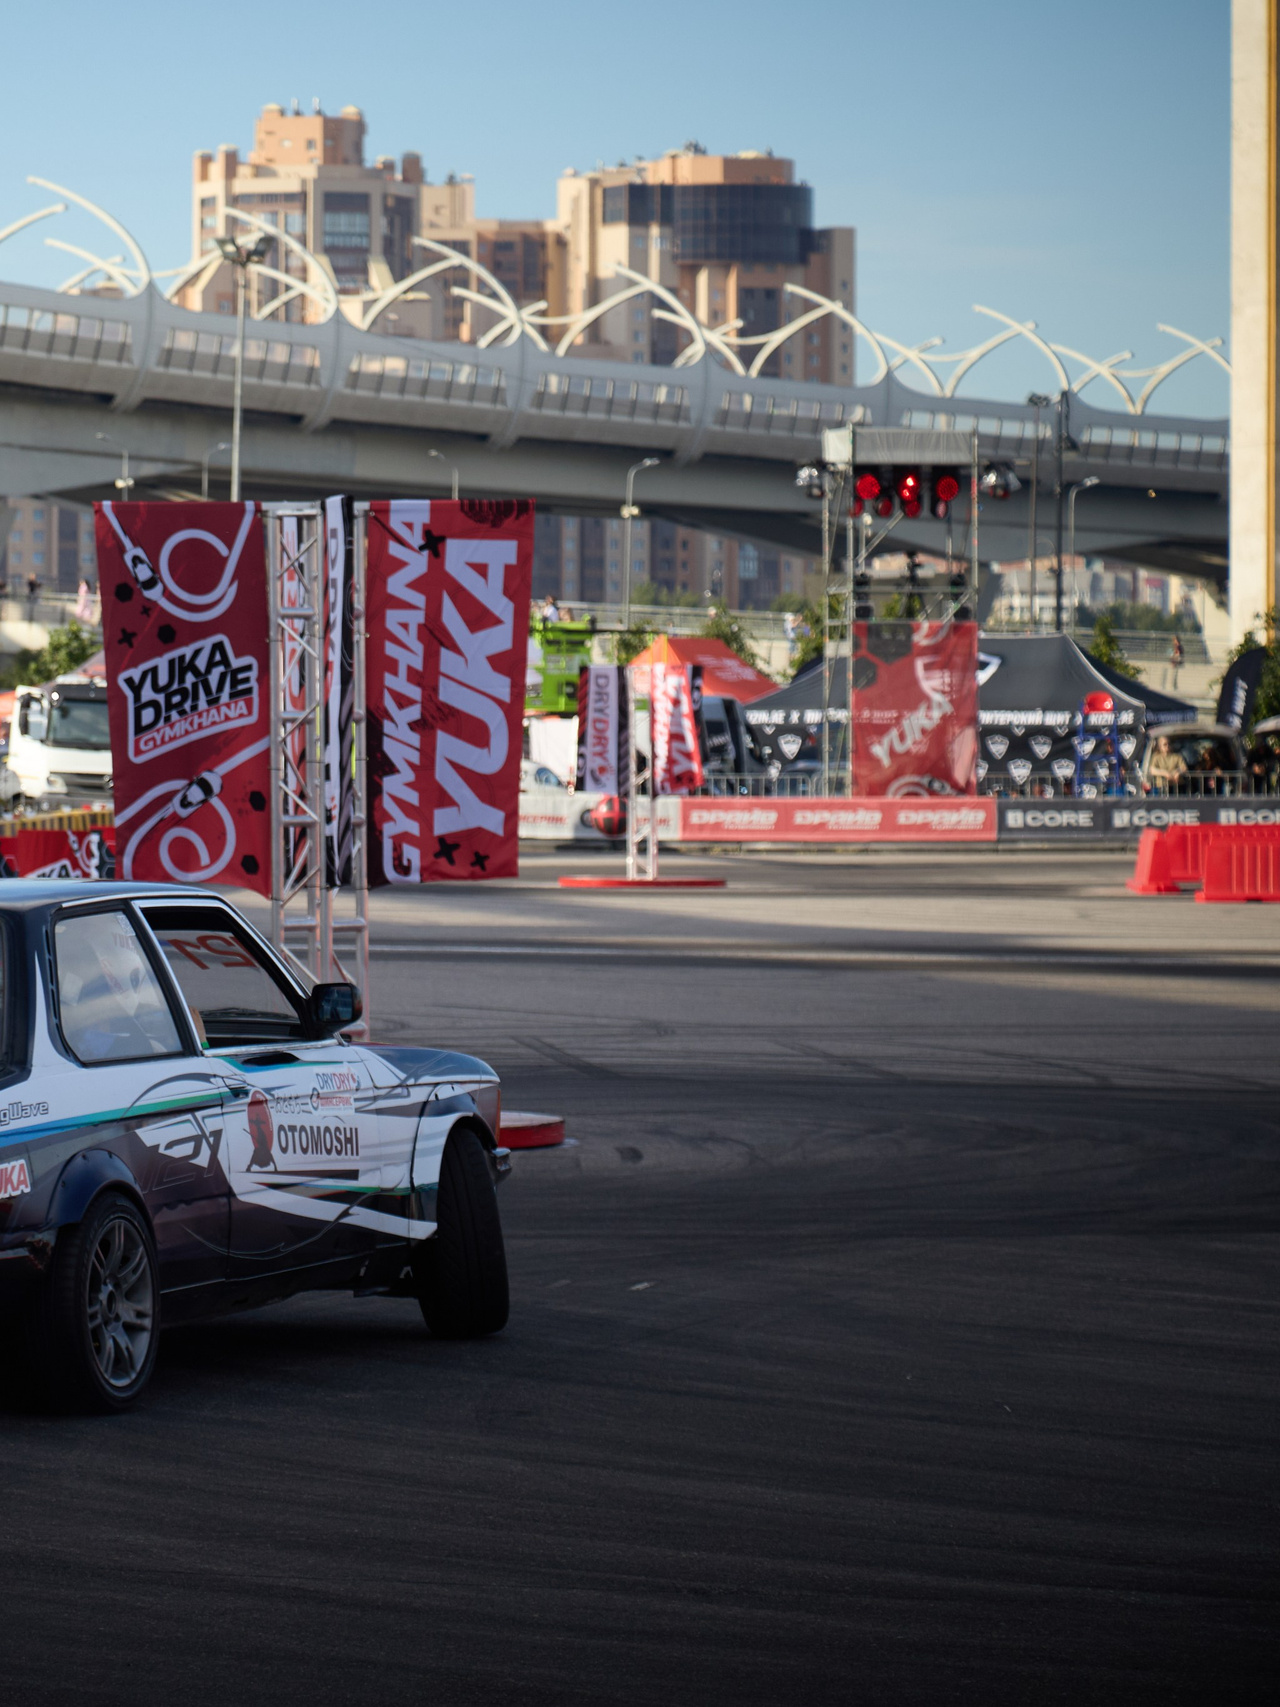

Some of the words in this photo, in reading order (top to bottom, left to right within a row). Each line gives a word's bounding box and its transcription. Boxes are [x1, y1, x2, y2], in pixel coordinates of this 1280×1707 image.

[123, 640, 233, 705] YUKA
[134, 663, 253, 738] DRIVE
[383, 499, 431, 883] GYMKHANA
[433, 538, 518, 837] YUKA
[139, 700, 248, 751] GYMKHANA
[592, 674, 609, 762] DRYDRY
[665, 675, 699, 776] YUKA
[870, 690, 955, 769] YUKA
[316, 1072, 351, 1091] DRYDRY
[277, 1124, 359, 1157] OTOMOSHI
